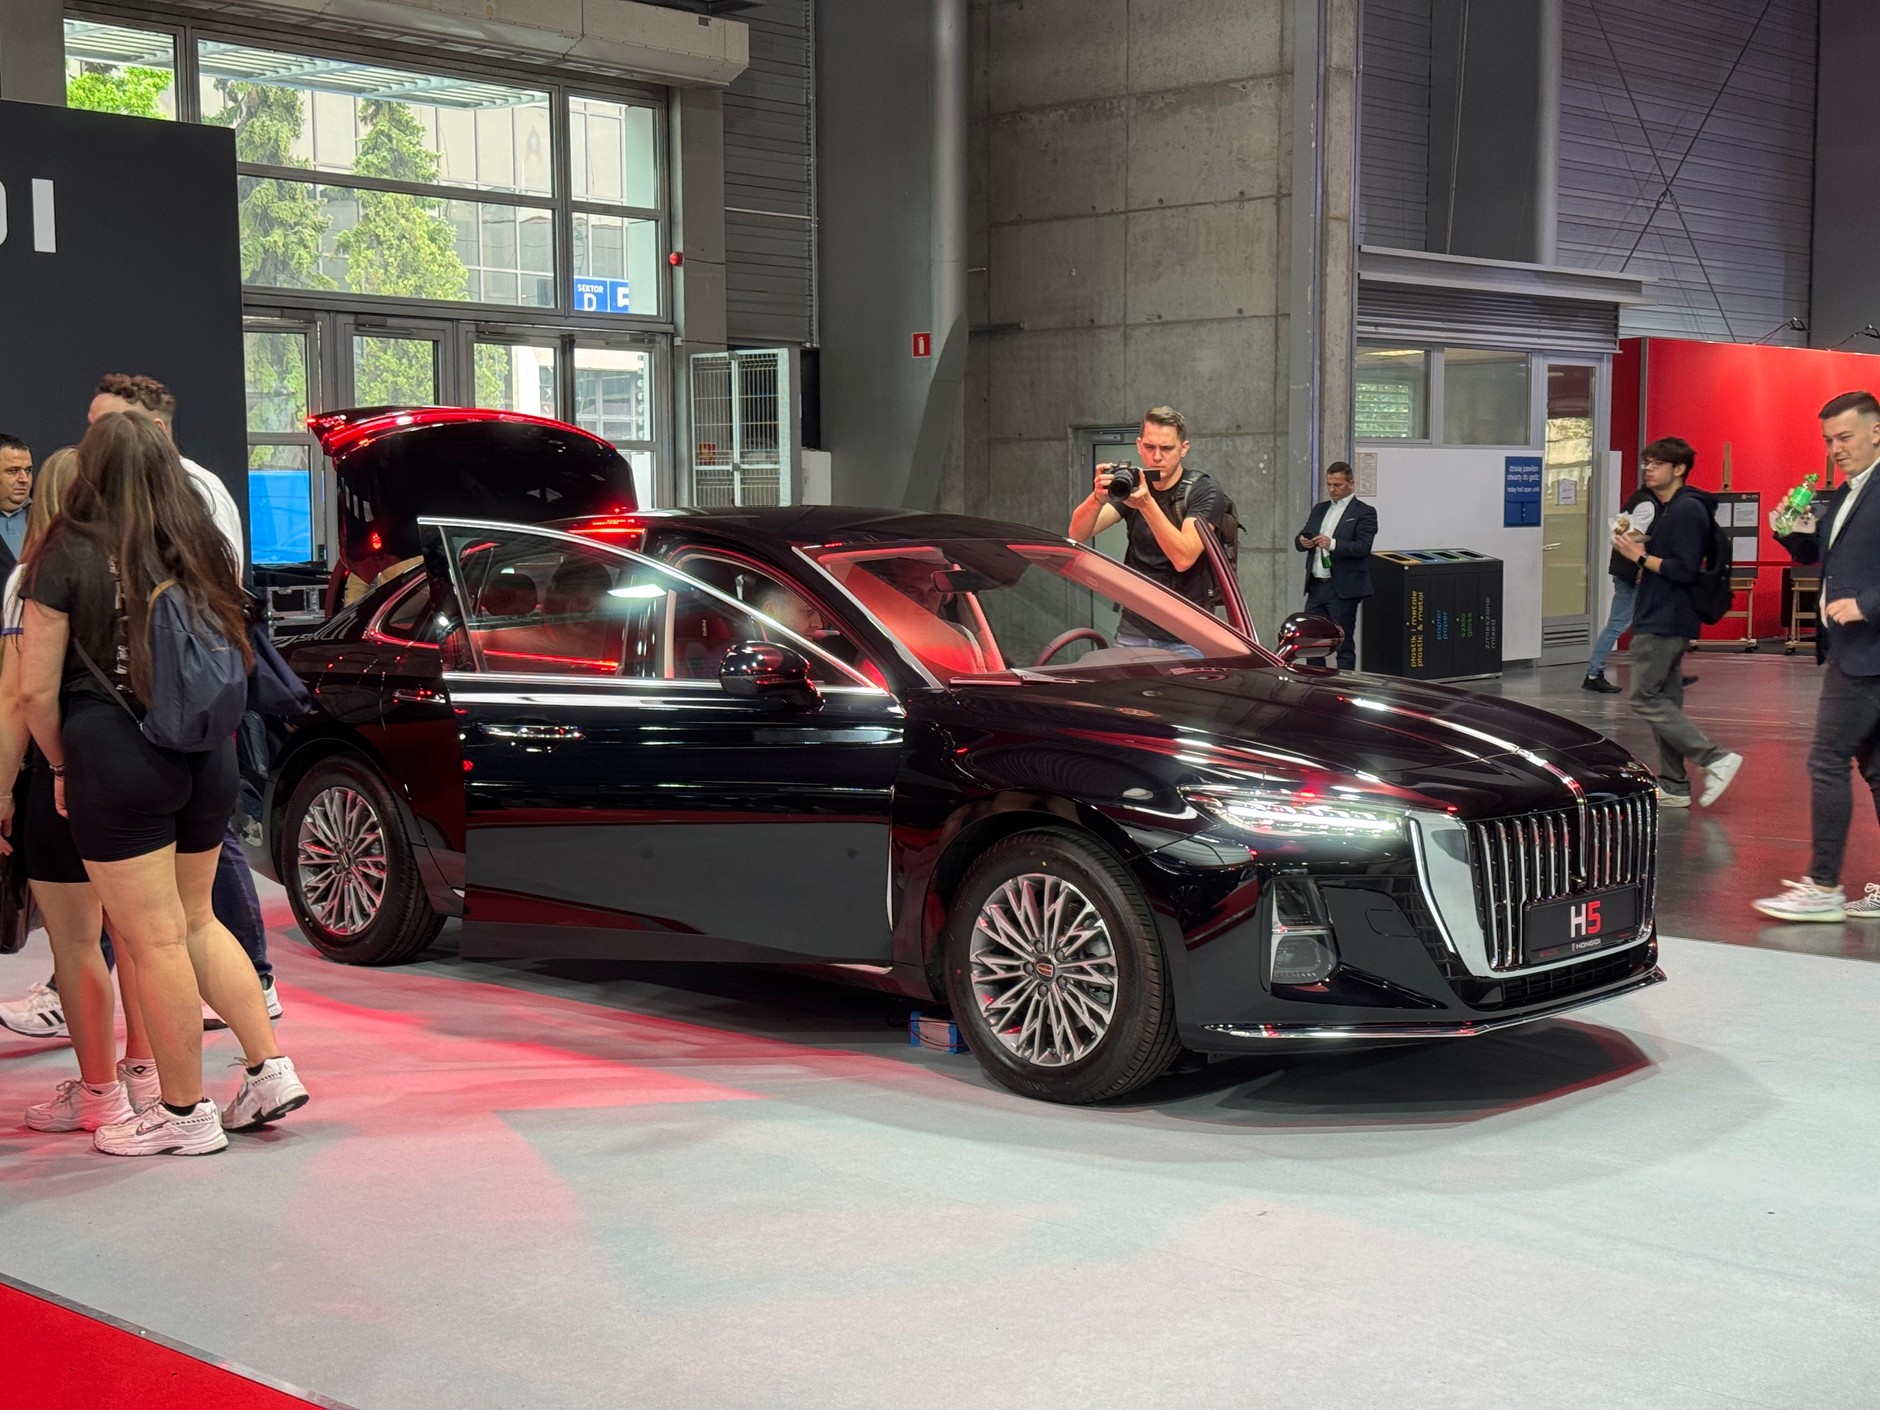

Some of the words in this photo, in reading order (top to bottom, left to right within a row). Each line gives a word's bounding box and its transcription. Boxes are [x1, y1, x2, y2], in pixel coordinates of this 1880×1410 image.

[577, 284, 604, 294] SEKTOR
[583, 292, 597, 311] D
[1417, 623, 1424, 631] &
[1570, 900, 1602, 938] H5
